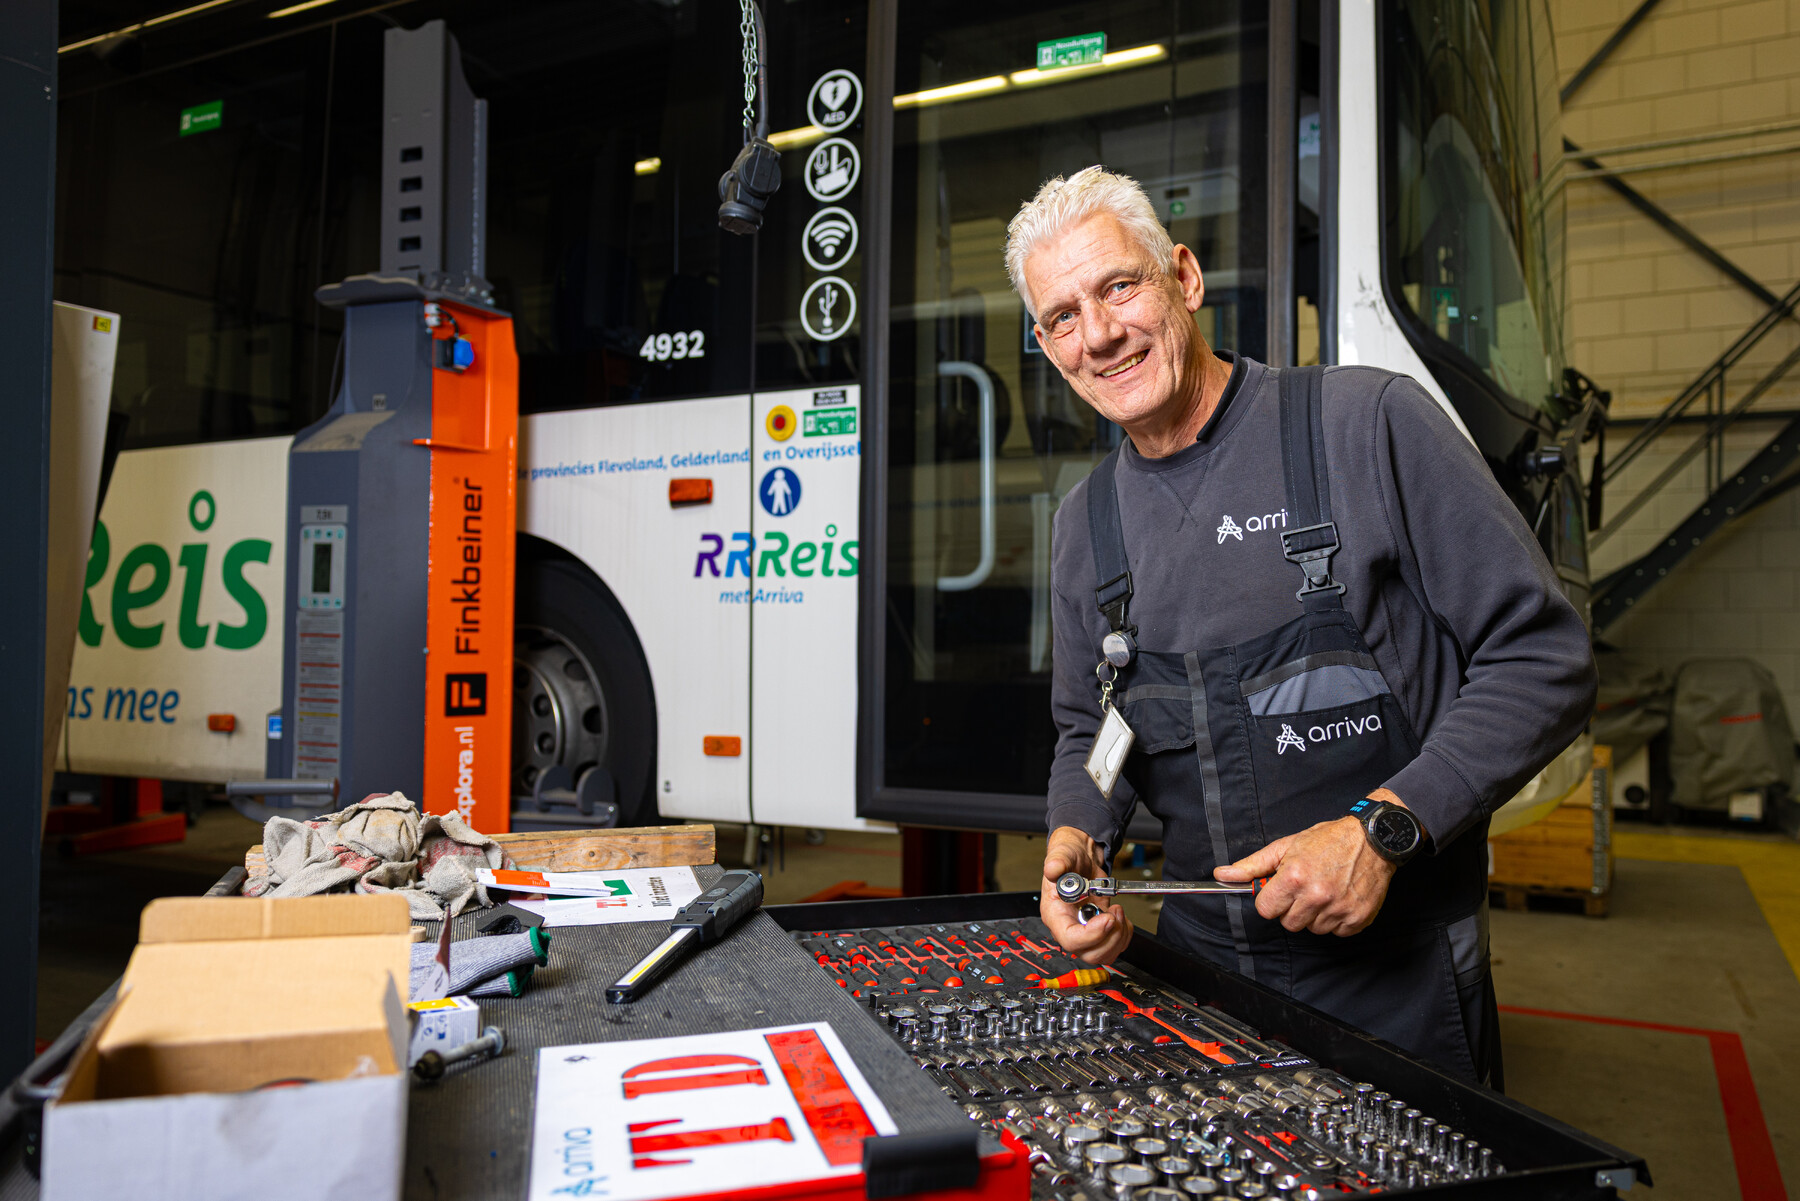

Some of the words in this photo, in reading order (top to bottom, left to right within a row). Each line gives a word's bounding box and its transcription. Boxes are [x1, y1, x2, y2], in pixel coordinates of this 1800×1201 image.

[822, 110, 847, 124] AED
[639, 329, 705, 362] 4932
[531, 461, 595, 481] provincies
[598, 455, 668, 474] Flevoland,
[671, 447, 750, 468] Gelderland
[763, 449, 782, 462] en
[786, 441, 861, 461] Overijssel
[1246, 508, 1289, 532] arri
[450, 477, 483, 655] Finkbeiner
[693, 523, 859, 578] RRReis
[719, 589, 752, 604] met
[752, 586, 804, 604] Arriva
[103, 687, 180, 723] mee
[1308, 714, 1383, 743] arriva
[651, 895, 673, 907] Niet
[620, 1054, 796, 1170] TD
[554, 1126, 593, 1177] arriva
